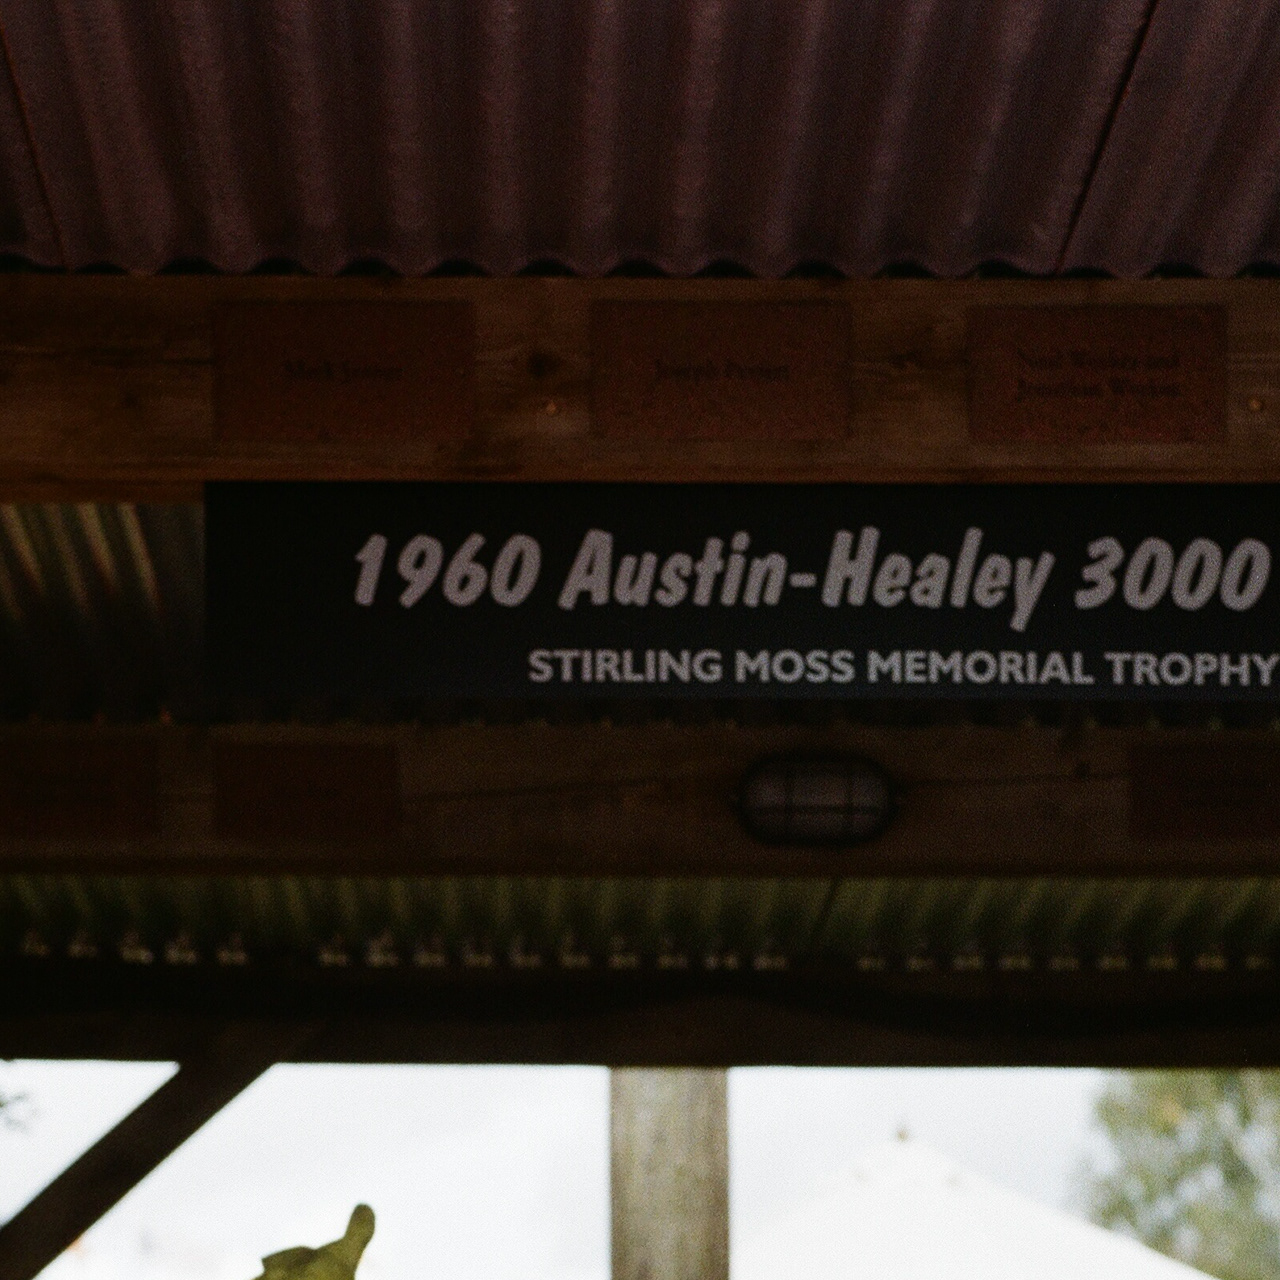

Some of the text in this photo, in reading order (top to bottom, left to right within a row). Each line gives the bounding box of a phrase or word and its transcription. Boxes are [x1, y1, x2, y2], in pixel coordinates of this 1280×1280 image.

[353, 533, 543, 609] 1960
[556, 525, 1056, 632] Austin-Healey
[1073, 535, 1272, 612] 3000
[527, 648, 1280, 688] STIRLING MOSS MEMORIAL TROPHY
